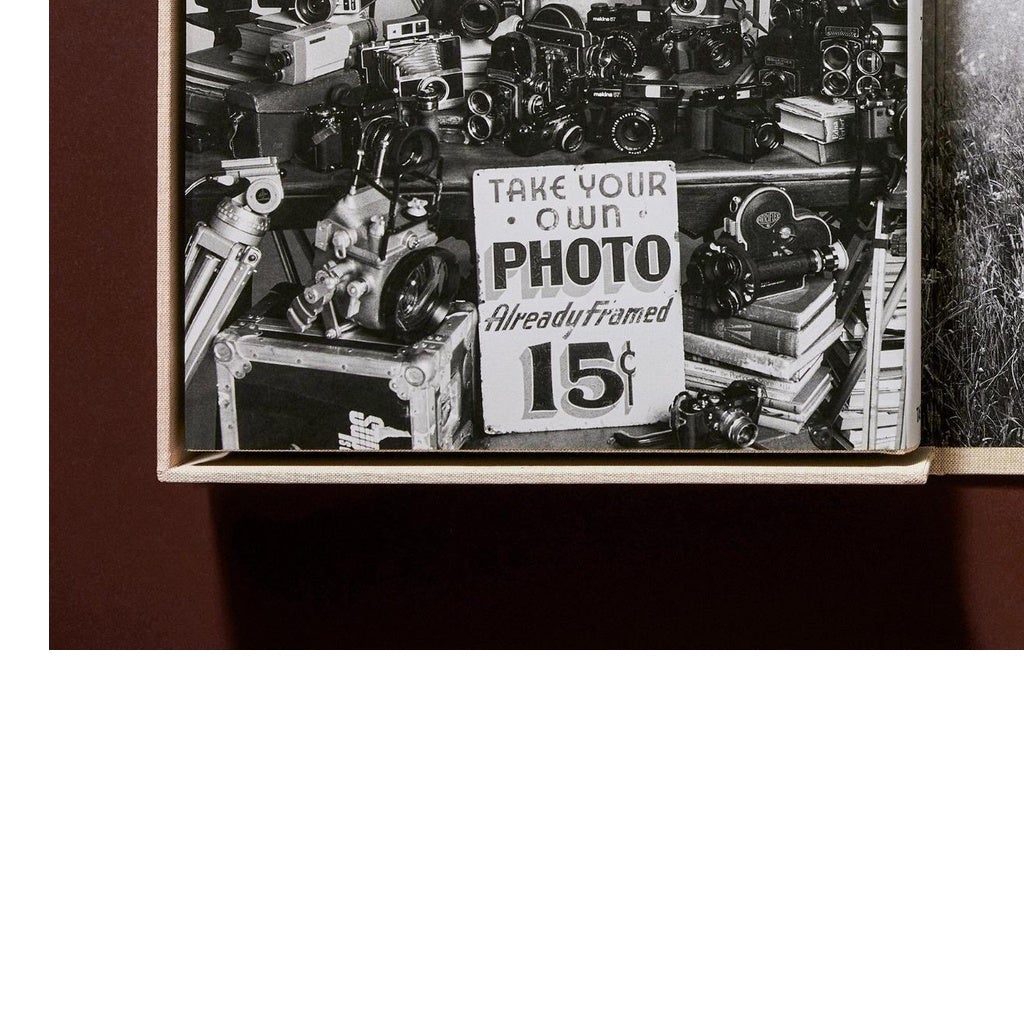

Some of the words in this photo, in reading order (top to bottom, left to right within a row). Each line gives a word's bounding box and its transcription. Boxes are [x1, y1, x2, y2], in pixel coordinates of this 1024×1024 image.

[488, 174, 567, 204] TAKE
[579, 170, 668, 199] YOUR
[492, 233, 672, 292] PHOTO
[484, 301, 580, 340] Already
